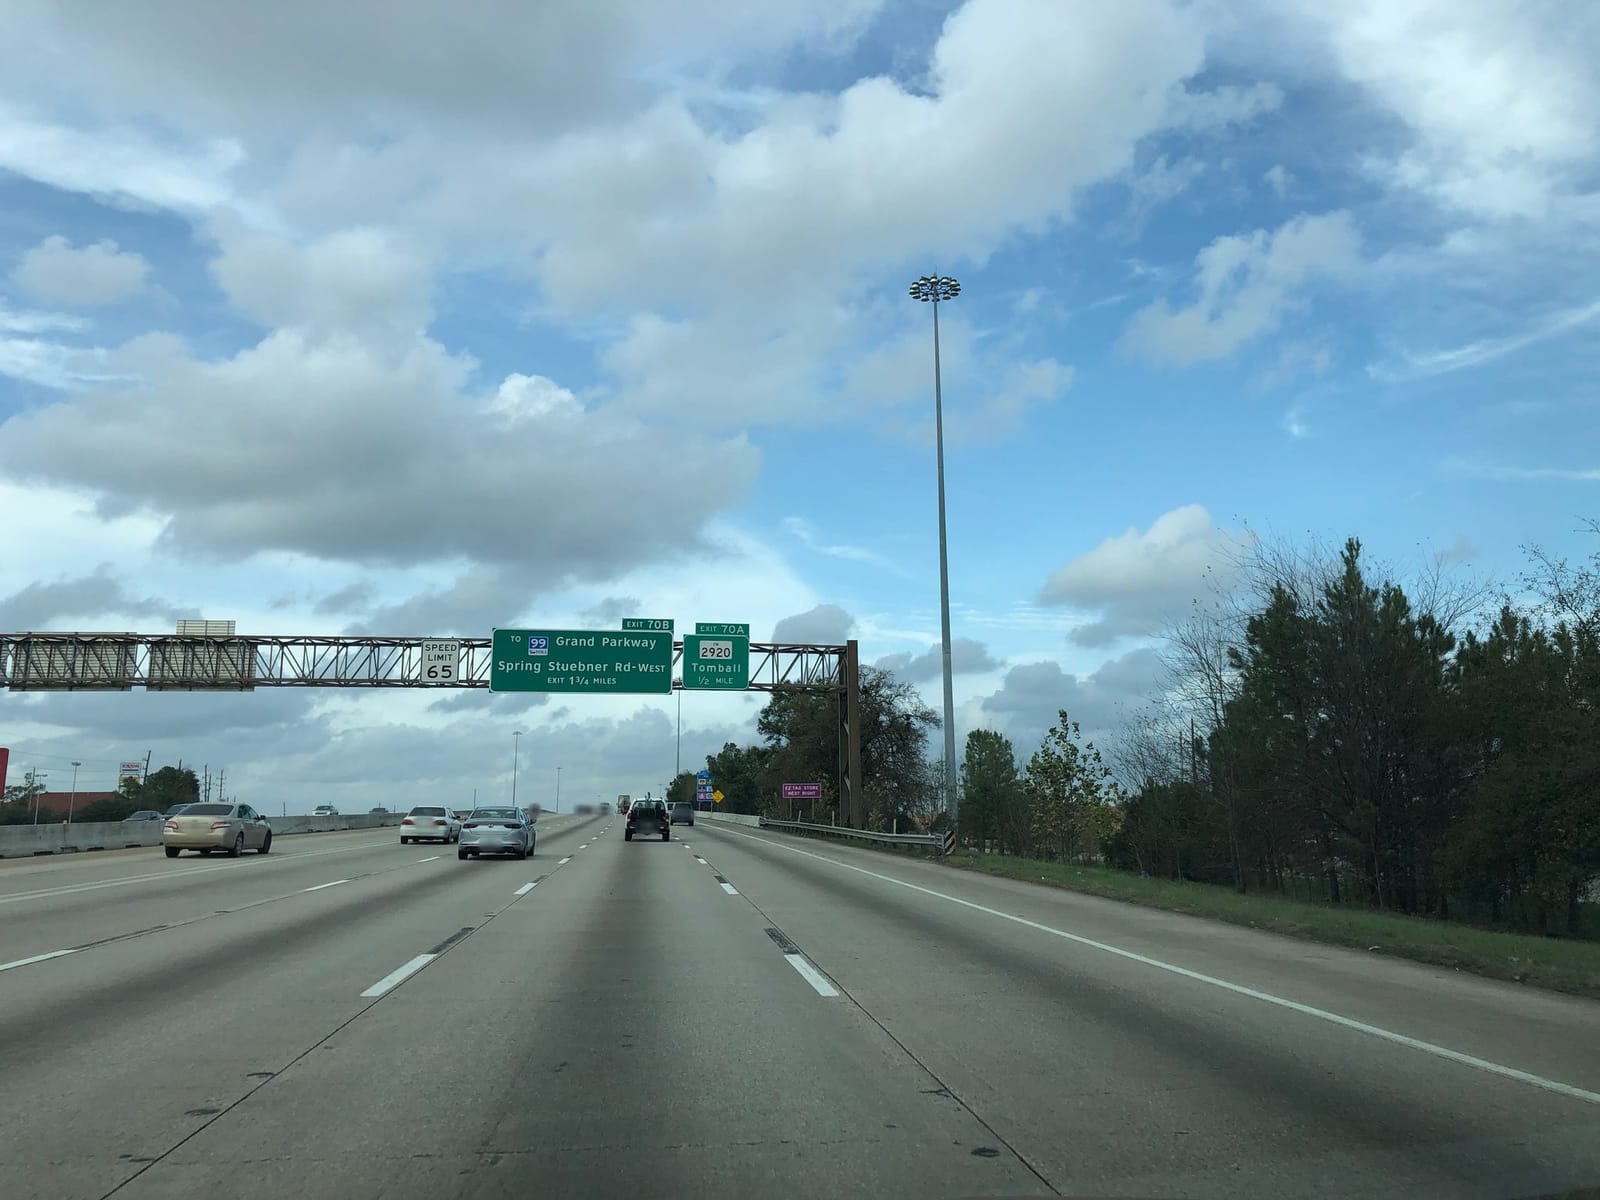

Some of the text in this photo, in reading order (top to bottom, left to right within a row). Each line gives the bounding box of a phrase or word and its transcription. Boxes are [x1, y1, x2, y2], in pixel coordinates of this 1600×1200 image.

[648, 620, 669, 630] 70B
[721, 625, 744, 634] 70A
[425, 644, 457, 652] SPEED
[530, 638, 546, 648] 99
[556, 636, 595, 646] Grand
[602, 637, 656, 650] Parkway
[702, 647, 730, 658] 2920
[428, 654, 453, 662] LIMIT
[427, 665, 452, 678] 65
[498, 660, 541, 674] Spring
[548, 661, 608, 672] Stuebner
[692, 663, 740, 672] Tomball
